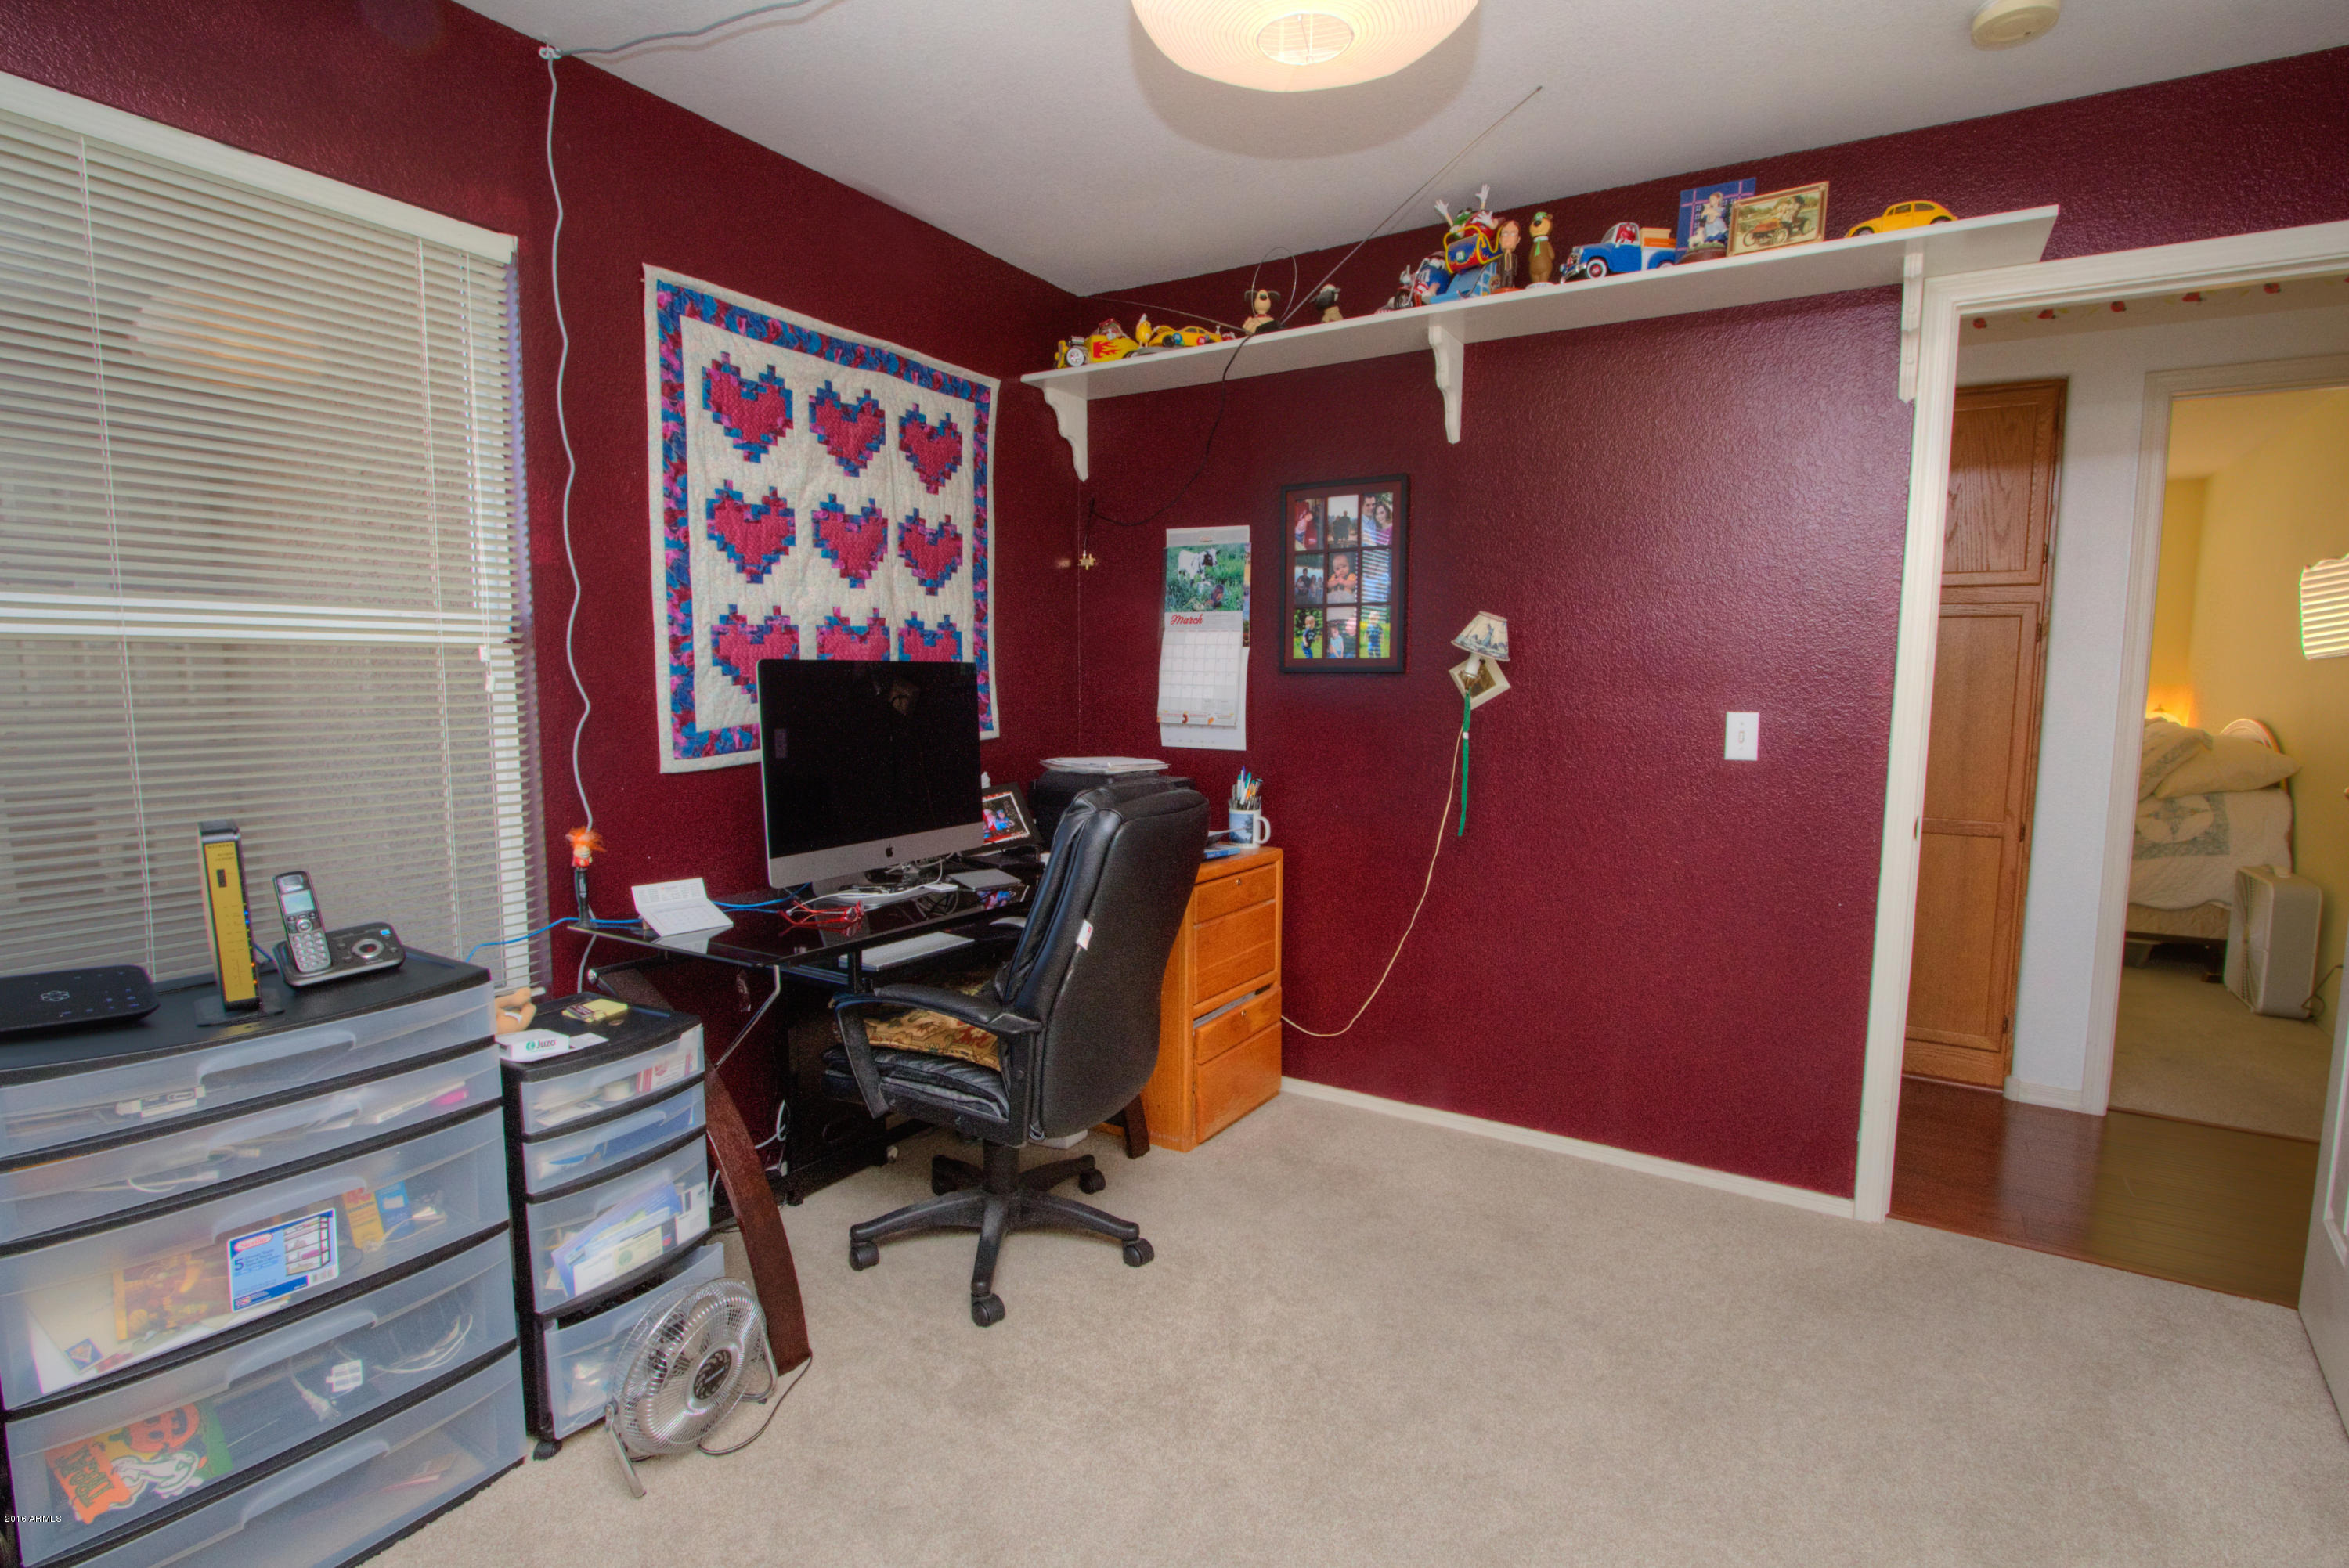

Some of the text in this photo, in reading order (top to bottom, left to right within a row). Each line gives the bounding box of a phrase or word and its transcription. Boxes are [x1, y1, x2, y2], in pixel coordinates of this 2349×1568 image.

[1171, 614, 1203, 625] March
[536, 1040, 557, 1049] Juzo
[234, 1258, 244, 1271] 5
